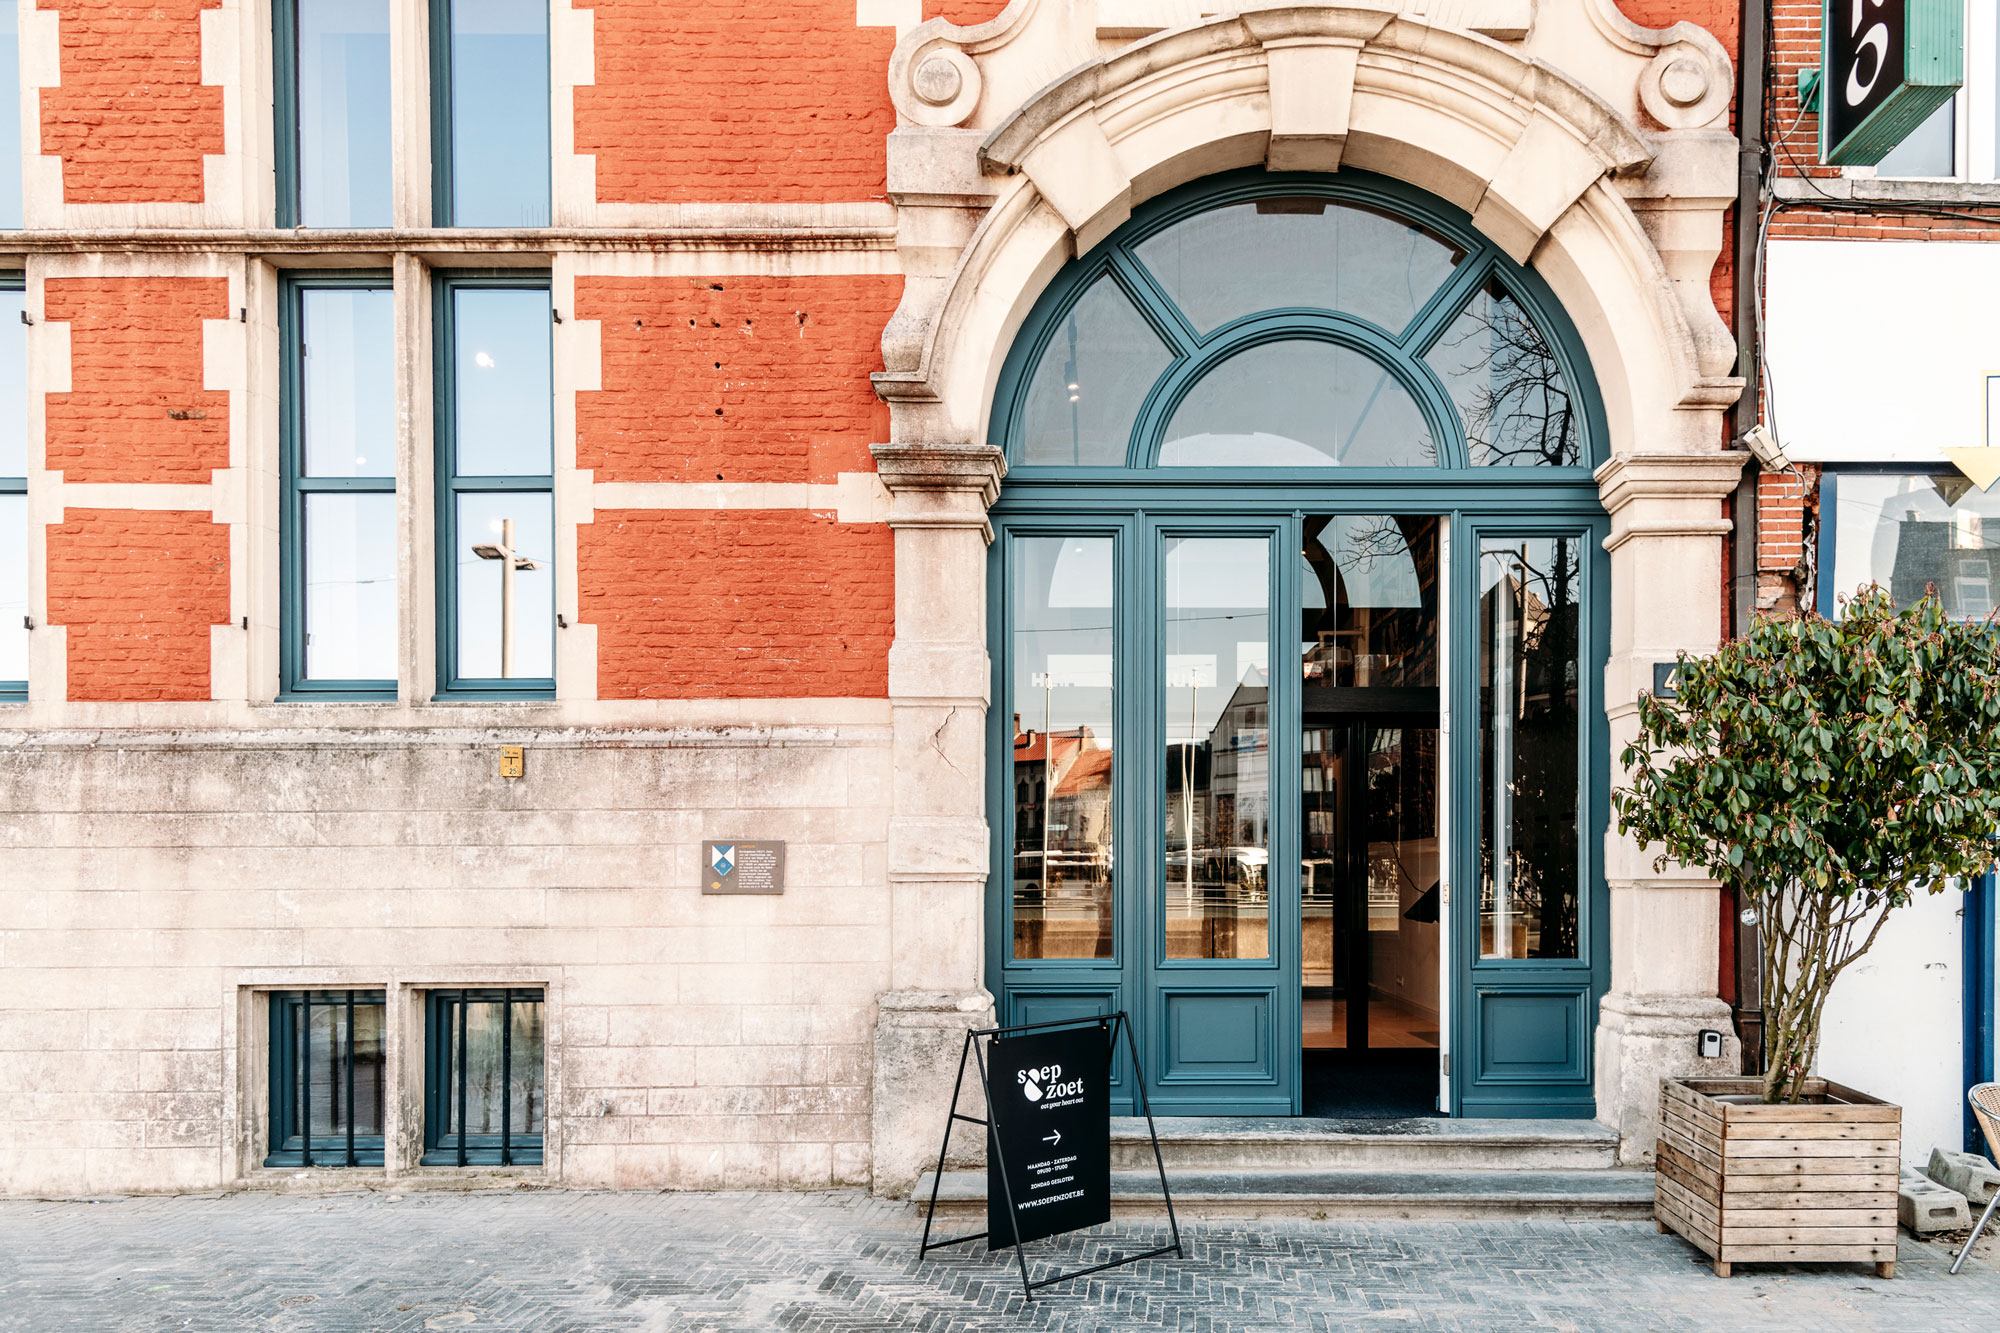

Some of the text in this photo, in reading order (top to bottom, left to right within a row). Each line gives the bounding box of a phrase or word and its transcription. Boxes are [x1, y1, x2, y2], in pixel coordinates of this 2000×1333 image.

[1045, 1077, 1084, 1100] zoet
[1049, 1101, 1062, 1110] your
[1061, 1098, 1075, 1107] heart
[1027, 1160, 1051, 1170] MAANDAG
[1054, 1155, 1077, 1165] ZATERDAG
[1030, 1175, 1074, 1190] ZONDAG GESLOTEN
[1017, 1189, 1085, 1210] WWW.SOEPENZOET.BE
